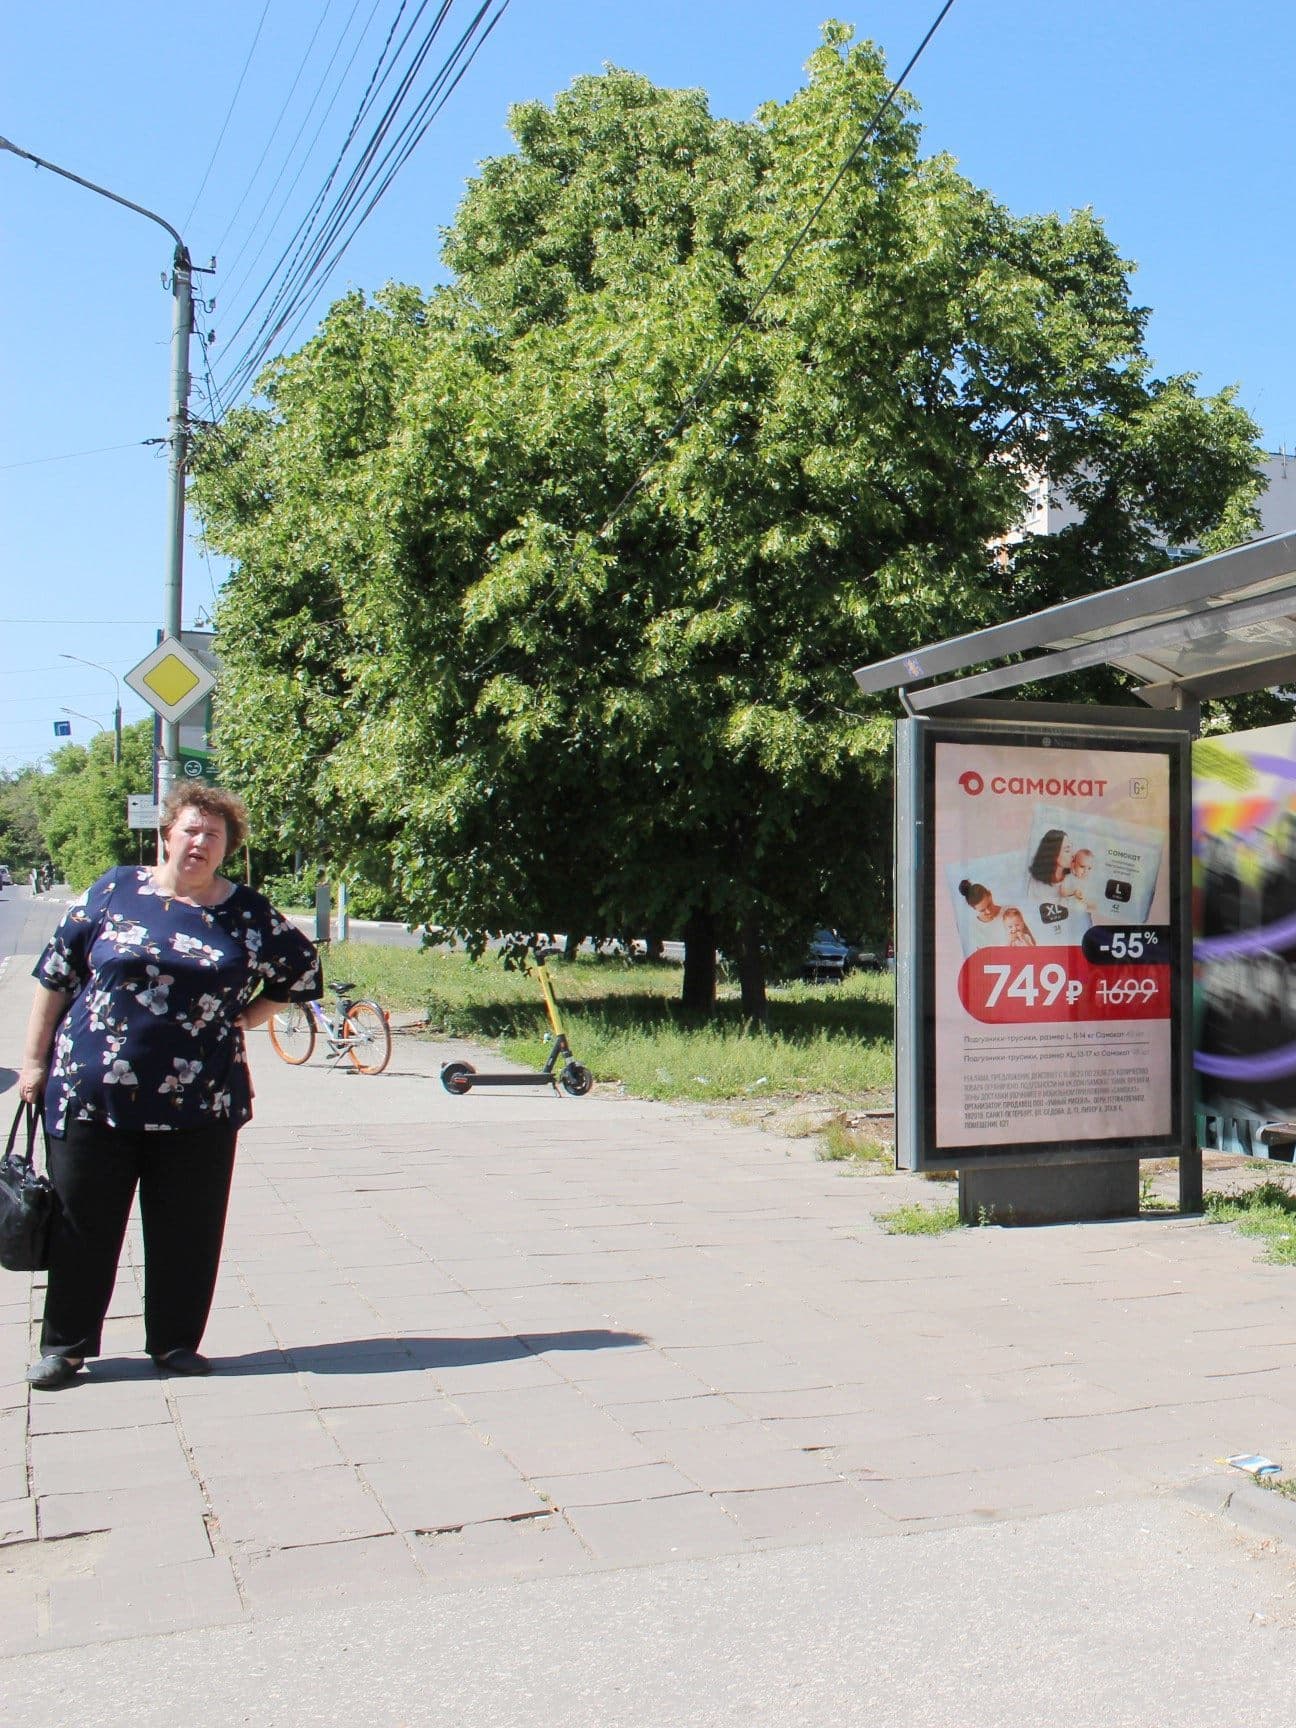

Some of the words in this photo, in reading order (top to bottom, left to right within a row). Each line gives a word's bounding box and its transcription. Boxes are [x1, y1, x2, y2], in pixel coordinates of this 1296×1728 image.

[991, 777, 1107, 797] самокат
[1115, 883, 1122, 895] L
[1046, 905, 1063, 916] XL
[1100, 932, 1158, 958] -55%
[1096, 978, 1158, 1004] 1699
